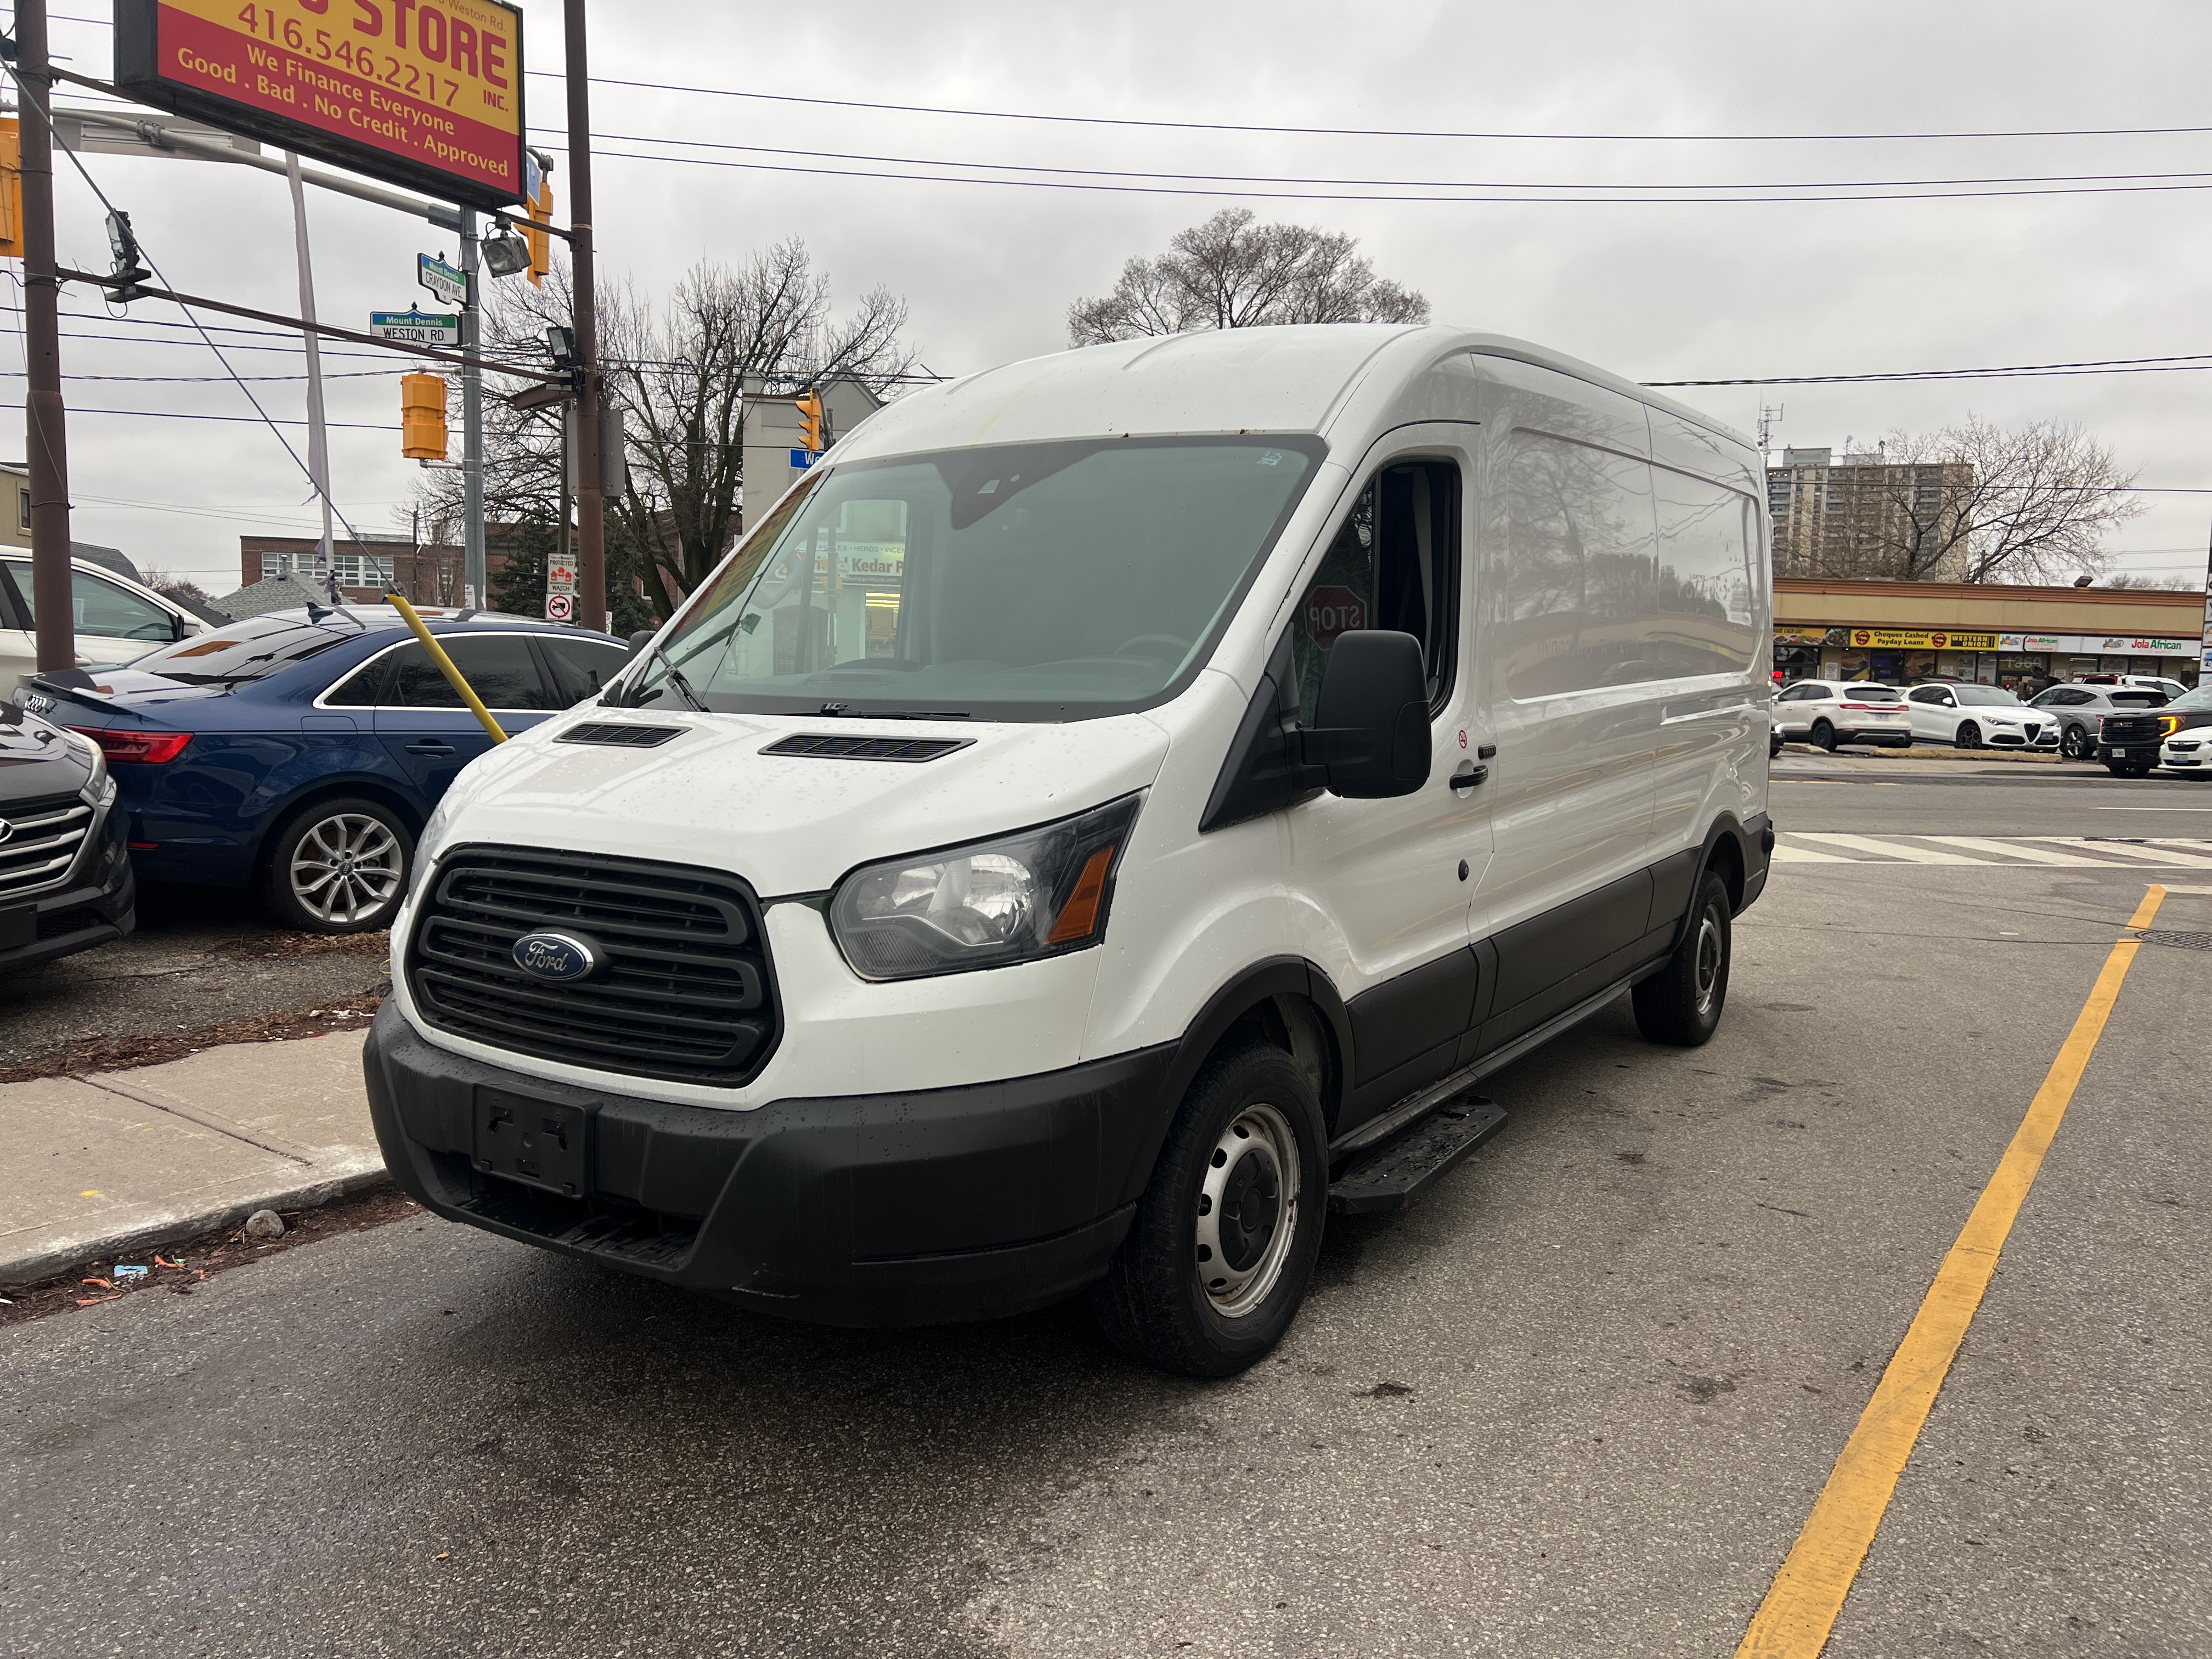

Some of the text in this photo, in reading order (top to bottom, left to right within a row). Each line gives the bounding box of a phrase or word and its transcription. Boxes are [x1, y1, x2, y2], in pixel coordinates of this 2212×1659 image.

[448, 0, 506, 32] Weston Rd.
[238, 2, 459, 107] 416.546.2217
[353, 0, 508, 90] STORE
[247, 43, 454, 136] We Finance Everyone
[483, 89, 509, 112] INC.
[178, 47, 236, 83] Good
[257, 74, 295, 104] Bad
[314, 95, 342, 120] No
[349, 107, 407, 144] Credit
[424, 134, 508, 177] Approved
[426, 271, 462, 298] CRAYDON AVE.
[429, 261, 459, 282] Mount Dennis
[383, 328, 446, 341] WESTON RD.
[386, 316, 443, 326] Mount Dennis
[852, 557, 894, 573] Kedar
[2131, 639, 2182, 650] Jola African
[524, 941, 569, 972] Ford
